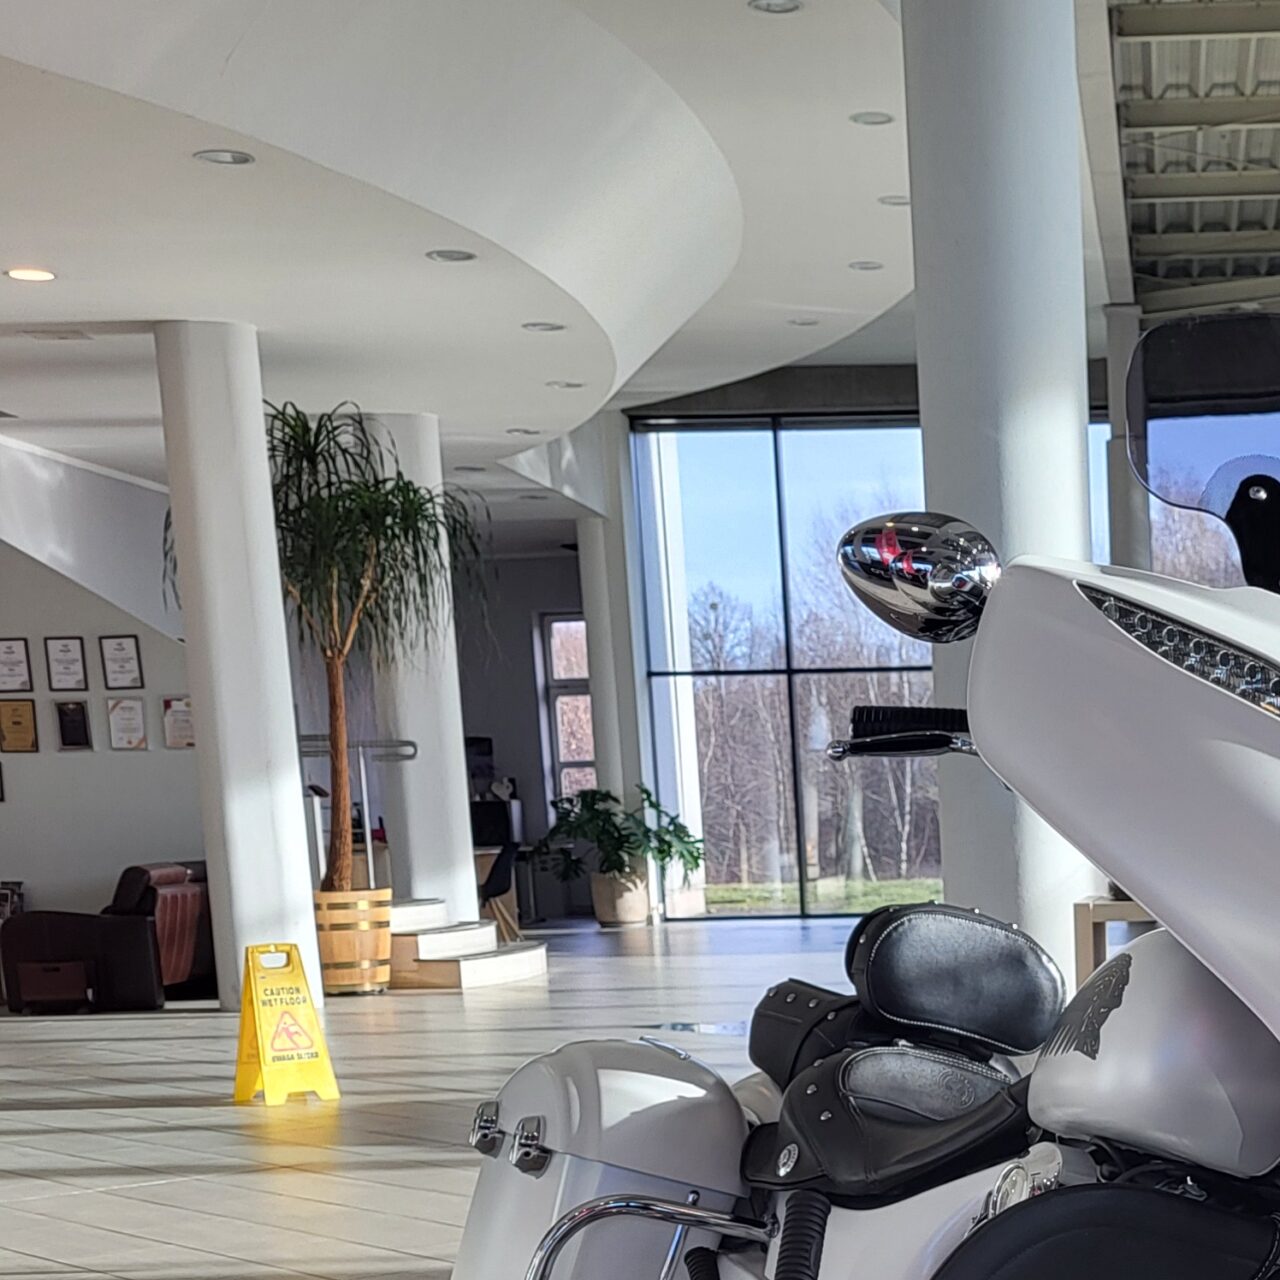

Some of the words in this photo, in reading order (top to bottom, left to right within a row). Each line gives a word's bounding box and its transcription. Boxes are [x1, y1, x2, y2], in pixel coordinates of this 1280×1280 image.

[263, 987, 301, 997] CAUTION
[260, 998, 278, 1007] WET
[280, 996, 307, 1006] FLOOR
